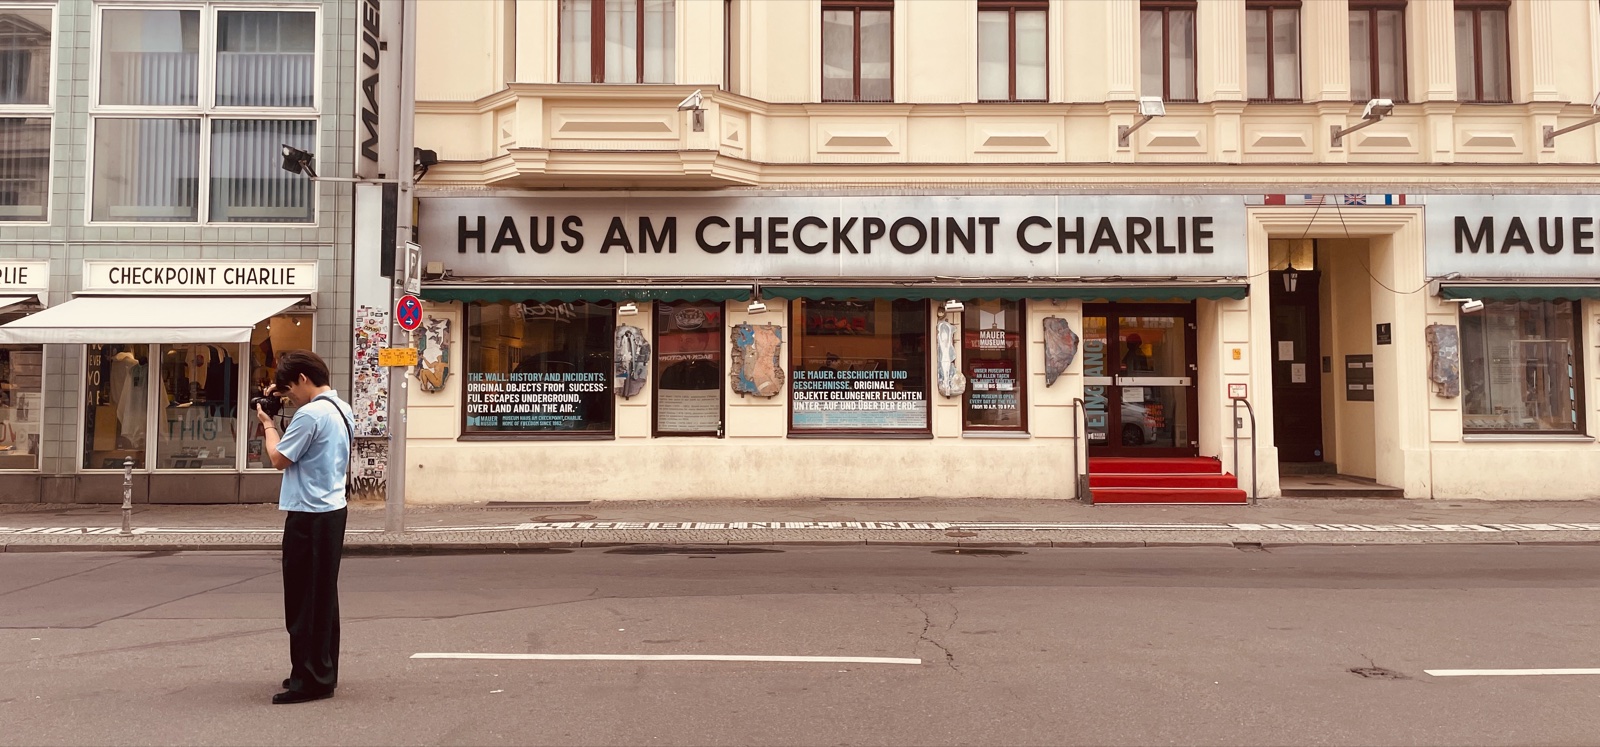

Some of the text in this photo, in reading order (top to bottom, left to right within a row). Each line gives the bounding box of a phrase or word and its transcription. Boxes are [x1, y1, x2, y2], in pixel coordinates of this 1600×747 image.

[362, 0, 380, 162] MAUE
[458, 215, 1214, 254] HAUS AM CHECKPOINT CHARLIE
[1454, 216, 1600, 254] MAUE
[109, 267, 295, 285] CHECKPOINT CHARLIE
[980, 331, 1005, 339] MAUER
[468, 373, 606, 382] THE WALL. HISTORY AND INCIDENTS.
[793, 371, 908, 379] DIE MAUER. GESCHICHTEN UND
[468, 383, 608, 392] ORIGINAL OBJECTS FROM SUCCESS-
[793, 381, 894, 390] GESCHEHNISSE. ORIGINALE
[468, 394, 582, 404] FUL ESCAPES UNDERGROUND,
[794, 392, 922, 400] OBJEKTE GELUNGENER FLUCHTEN
[468, 404, 488, 412] OVER
[490, 404, 512, 412] LAND
[514, 404, 530, 412] AND
[531, 404, 540, 412] IN
[542, 404, 558, 412] THE
[794, 400, 919, 411] UNTER, AUF UND ÜBER DER ERDE.
